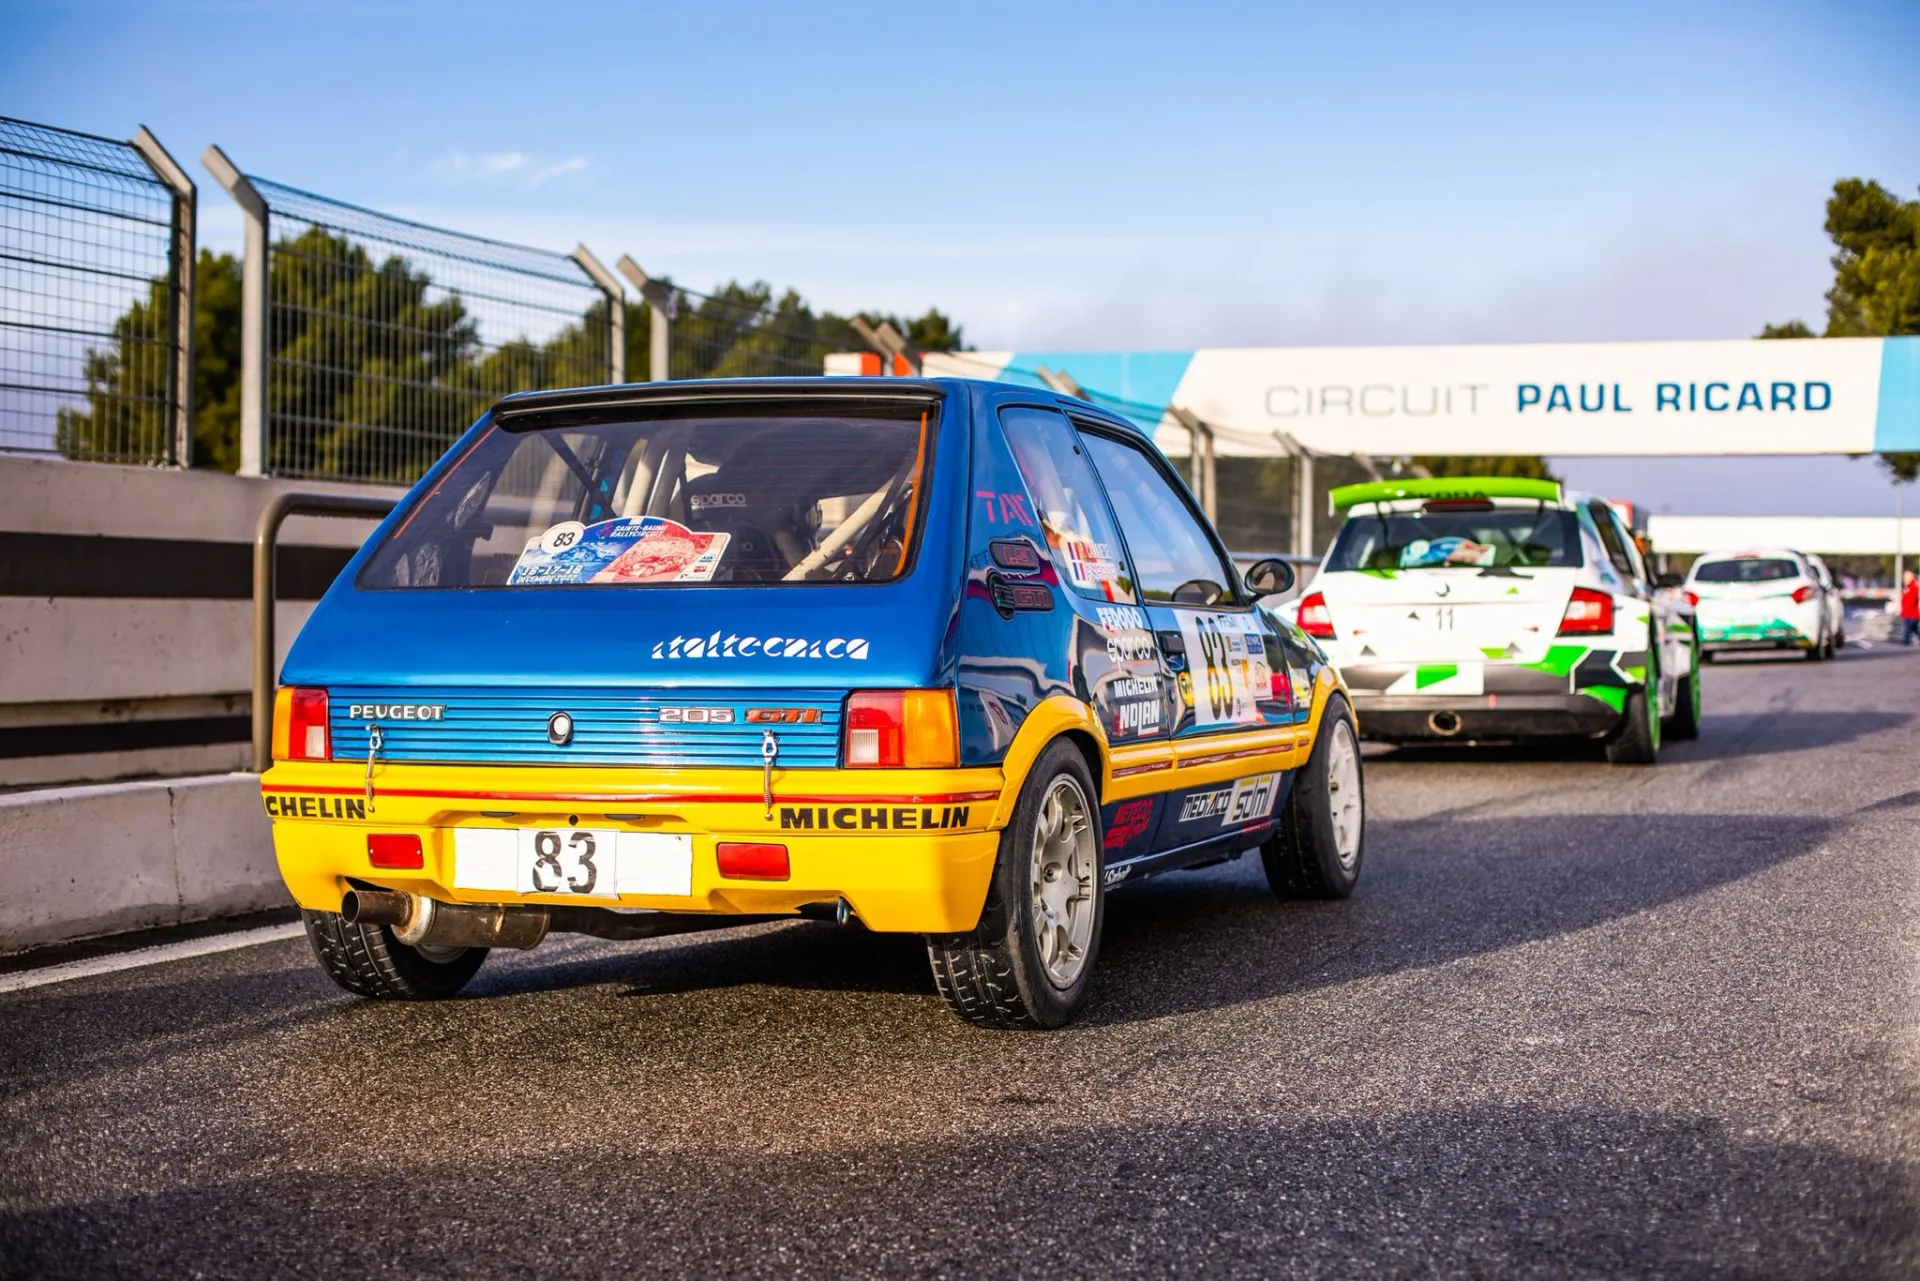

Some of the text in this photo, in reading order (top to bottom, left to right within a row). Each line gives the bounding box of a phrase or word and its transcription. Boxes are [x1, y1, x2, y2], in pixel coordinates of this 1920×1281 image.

[1264, 381, 1832, 417] CIRCUIT PAUL RICARD
[690, 493, 747, 510] sparco
[553, 532, 575, 547] 83
[1096, 607, 1143, 631] FERODO
[1436, 608, 1454, 630] 11
[652, 630, 870, 660] italtecnica
[1107, 636, 1152, 672] sparco
[1195, 616, 1233, 720] 83
[1114, 676, 1159, 698] MICHELIN
[350, 704, 443, 720] PEUGEOT
[659, 708, 819, 723] 205 GTI
[1120, 700, 1160, 736] NOLAN
[265, 796, 366, 819] CHELIN
[780, 806, 970, 830] MICHELIN
[531, 831, 599, 894] 83
